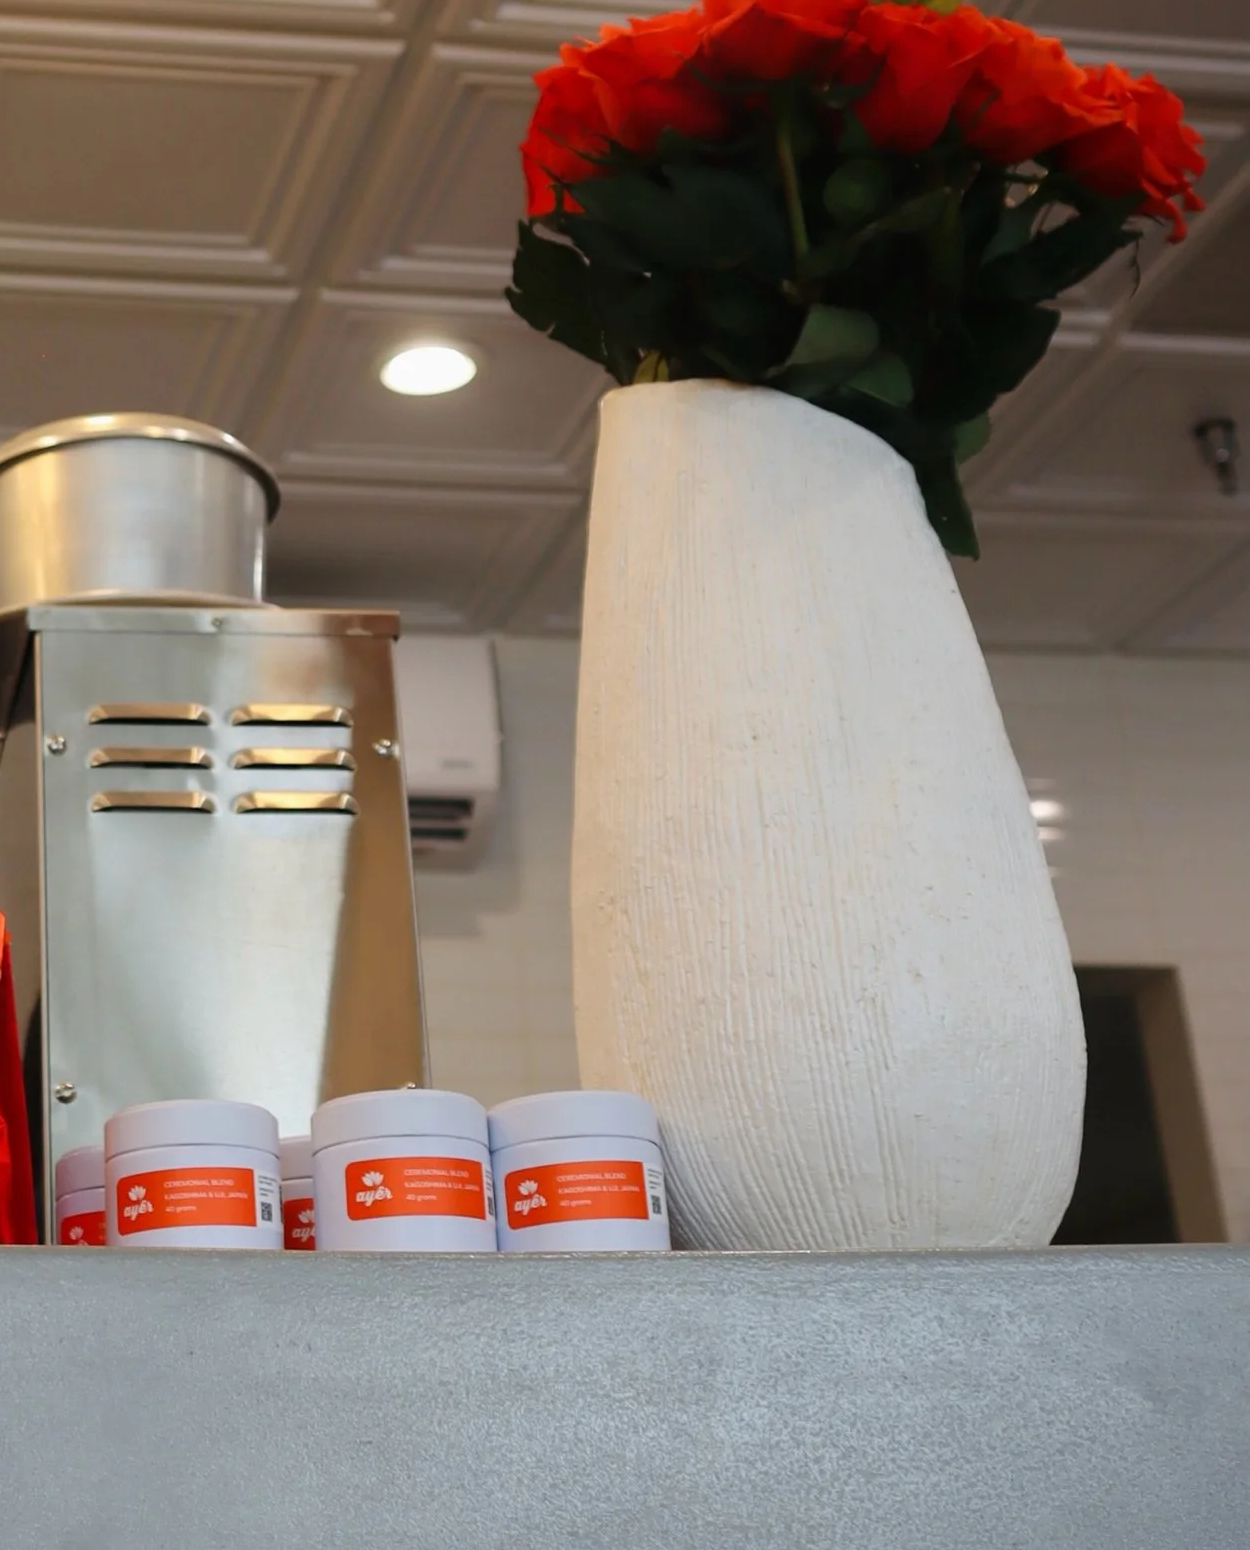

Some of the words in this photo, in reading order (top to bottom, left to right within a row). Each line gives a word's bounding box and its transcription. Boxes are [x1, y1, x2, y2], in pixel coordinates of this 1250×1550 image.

[450, 1169, 470, 1178] BLEND
[604, 1172, 626, 1180] BLEND
[210, 1178, 234, 1187] BLEND
[406, 1193, 416, 1201] 40
[416, 1194, 437, 1202] grams
[560, 1199, 570, 1207] 40
[570, 1199, 592, 1207] grams
[175, 1205, 197, 1213] grams
